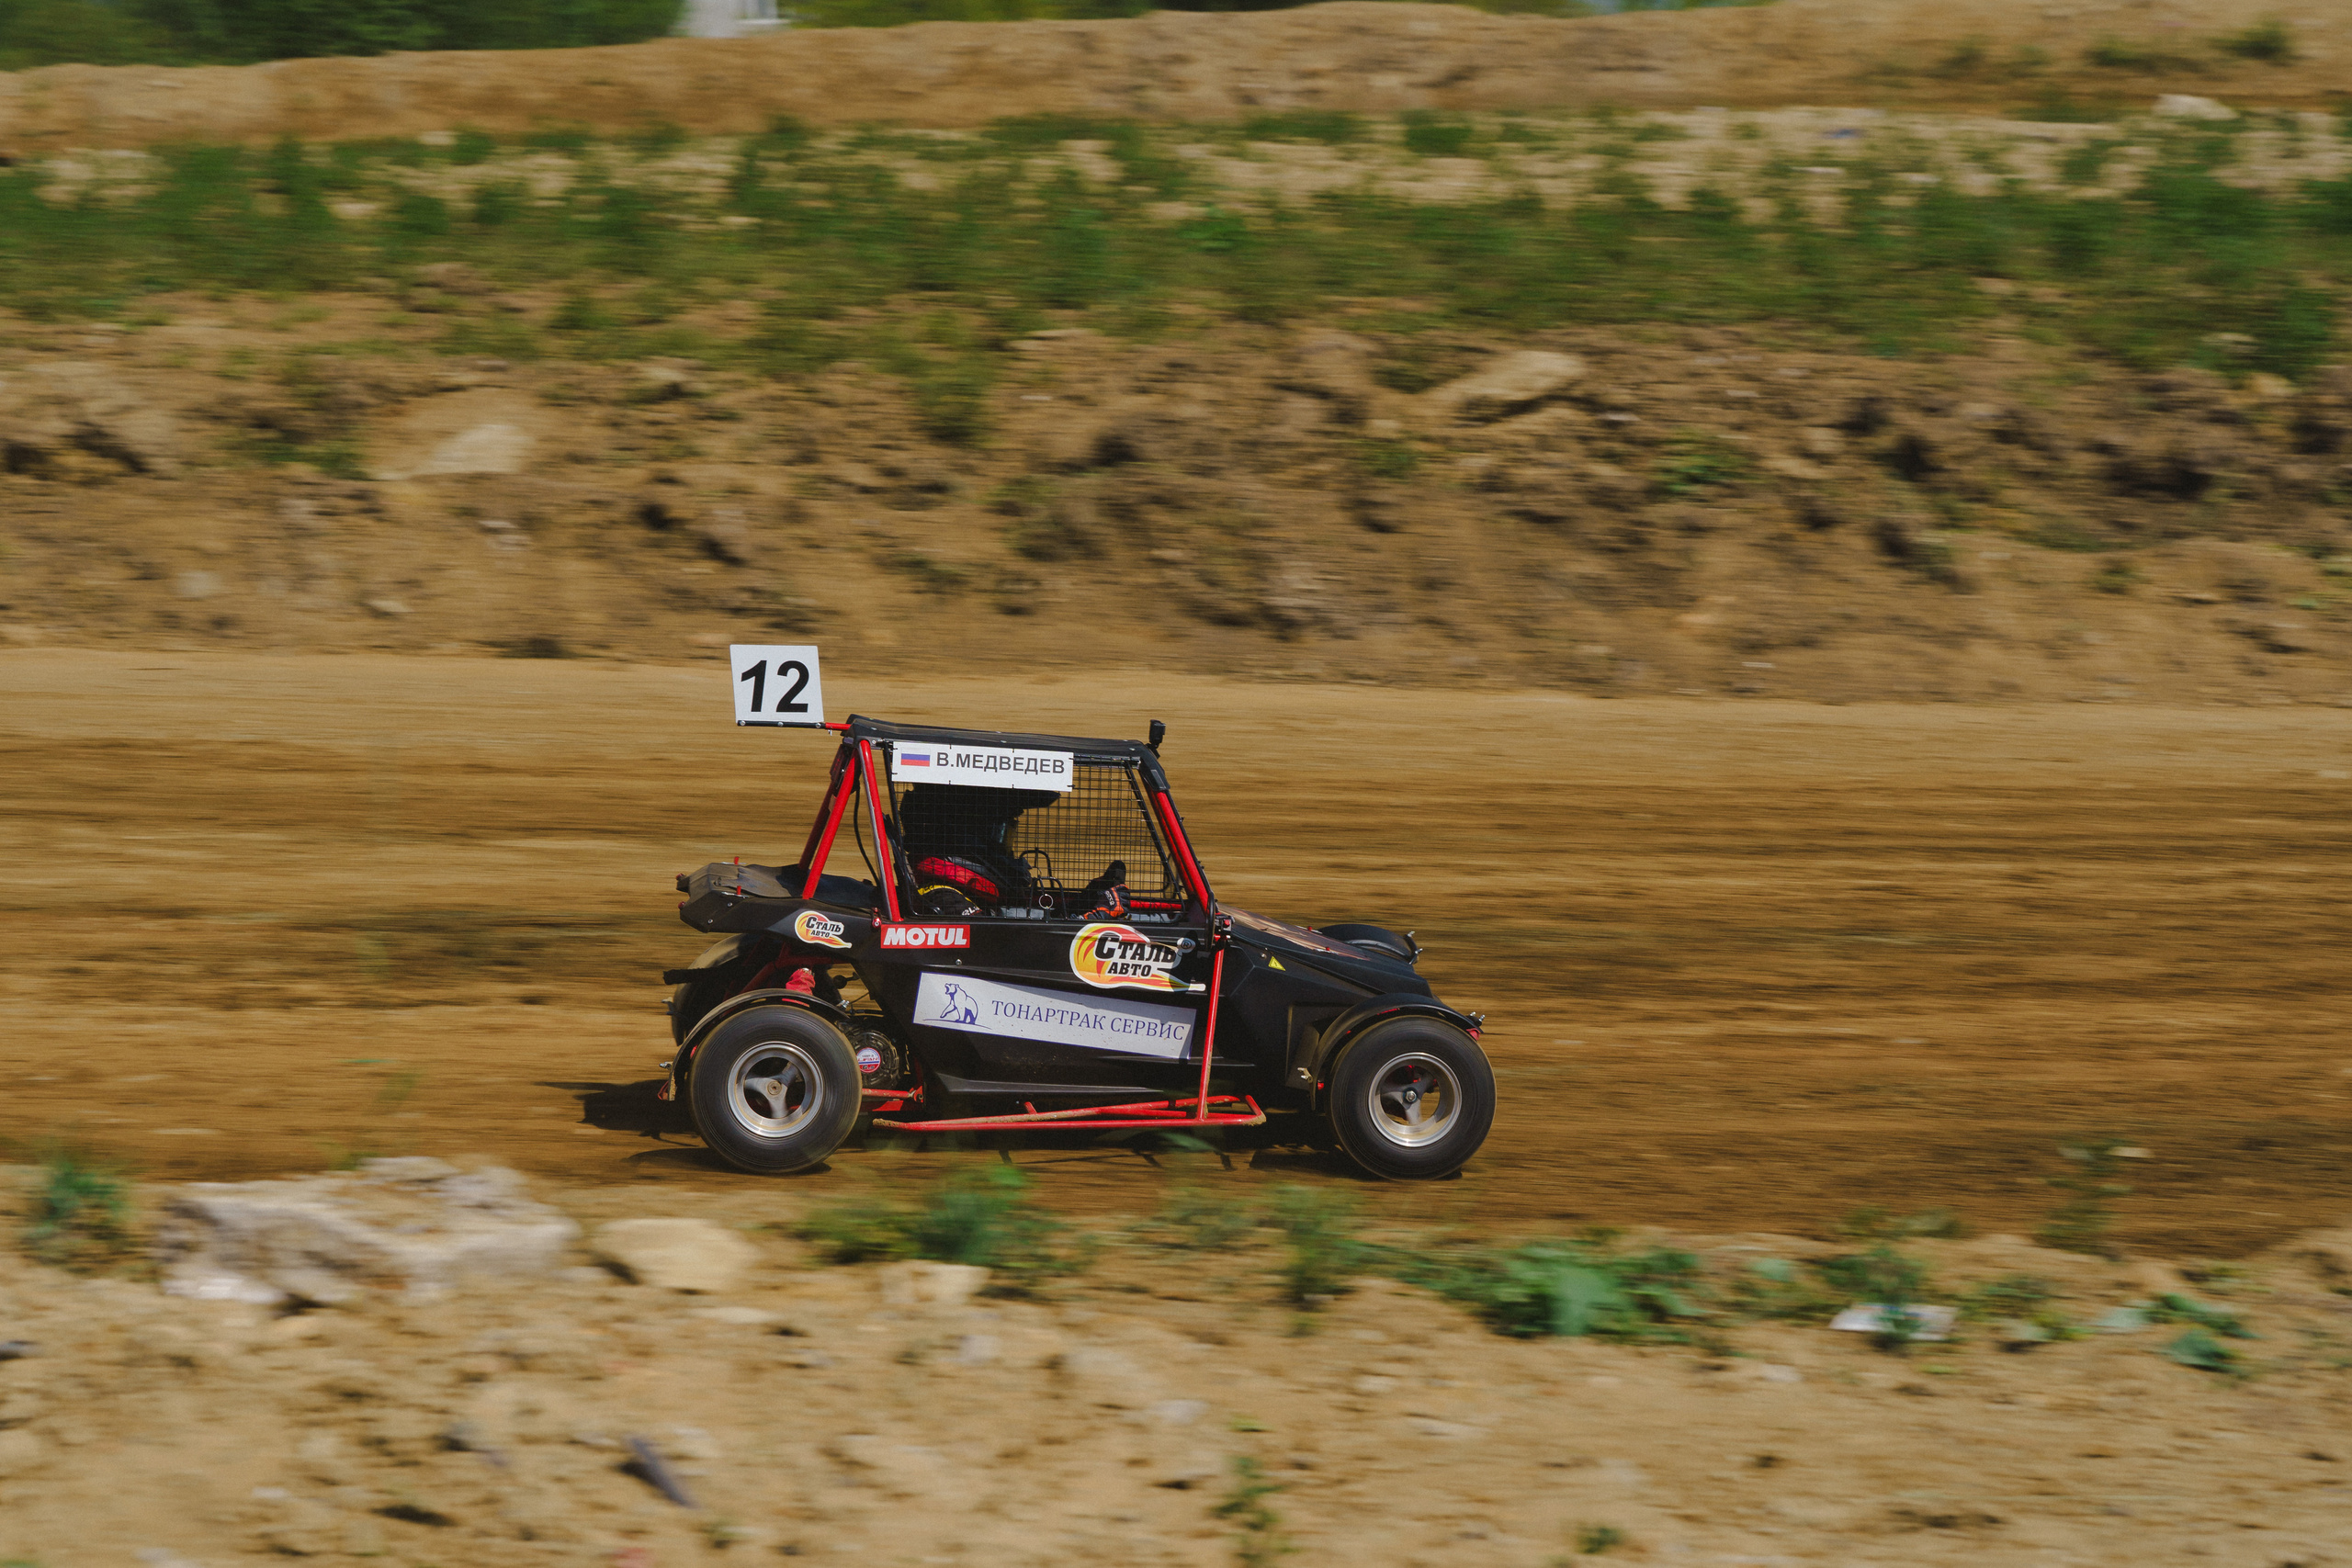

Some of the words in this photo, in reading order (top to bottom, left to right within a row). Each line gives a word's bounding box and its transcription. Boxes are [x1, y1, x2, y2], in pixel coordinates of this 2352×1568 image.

[741, 660, 809, 713] 12
[936, 751, 1065, 775] В.МЕДВЕДЕВ
[810, 930, 830, 938] АВТО
[883, 927, 967, 946] MOTUL
[1107, 962, 1152, 977] АВТО
[991, 1000, 1106, 1030] ТОНАРТРАК
[1110, 1017, 1186, 1041] СЕРВИС
